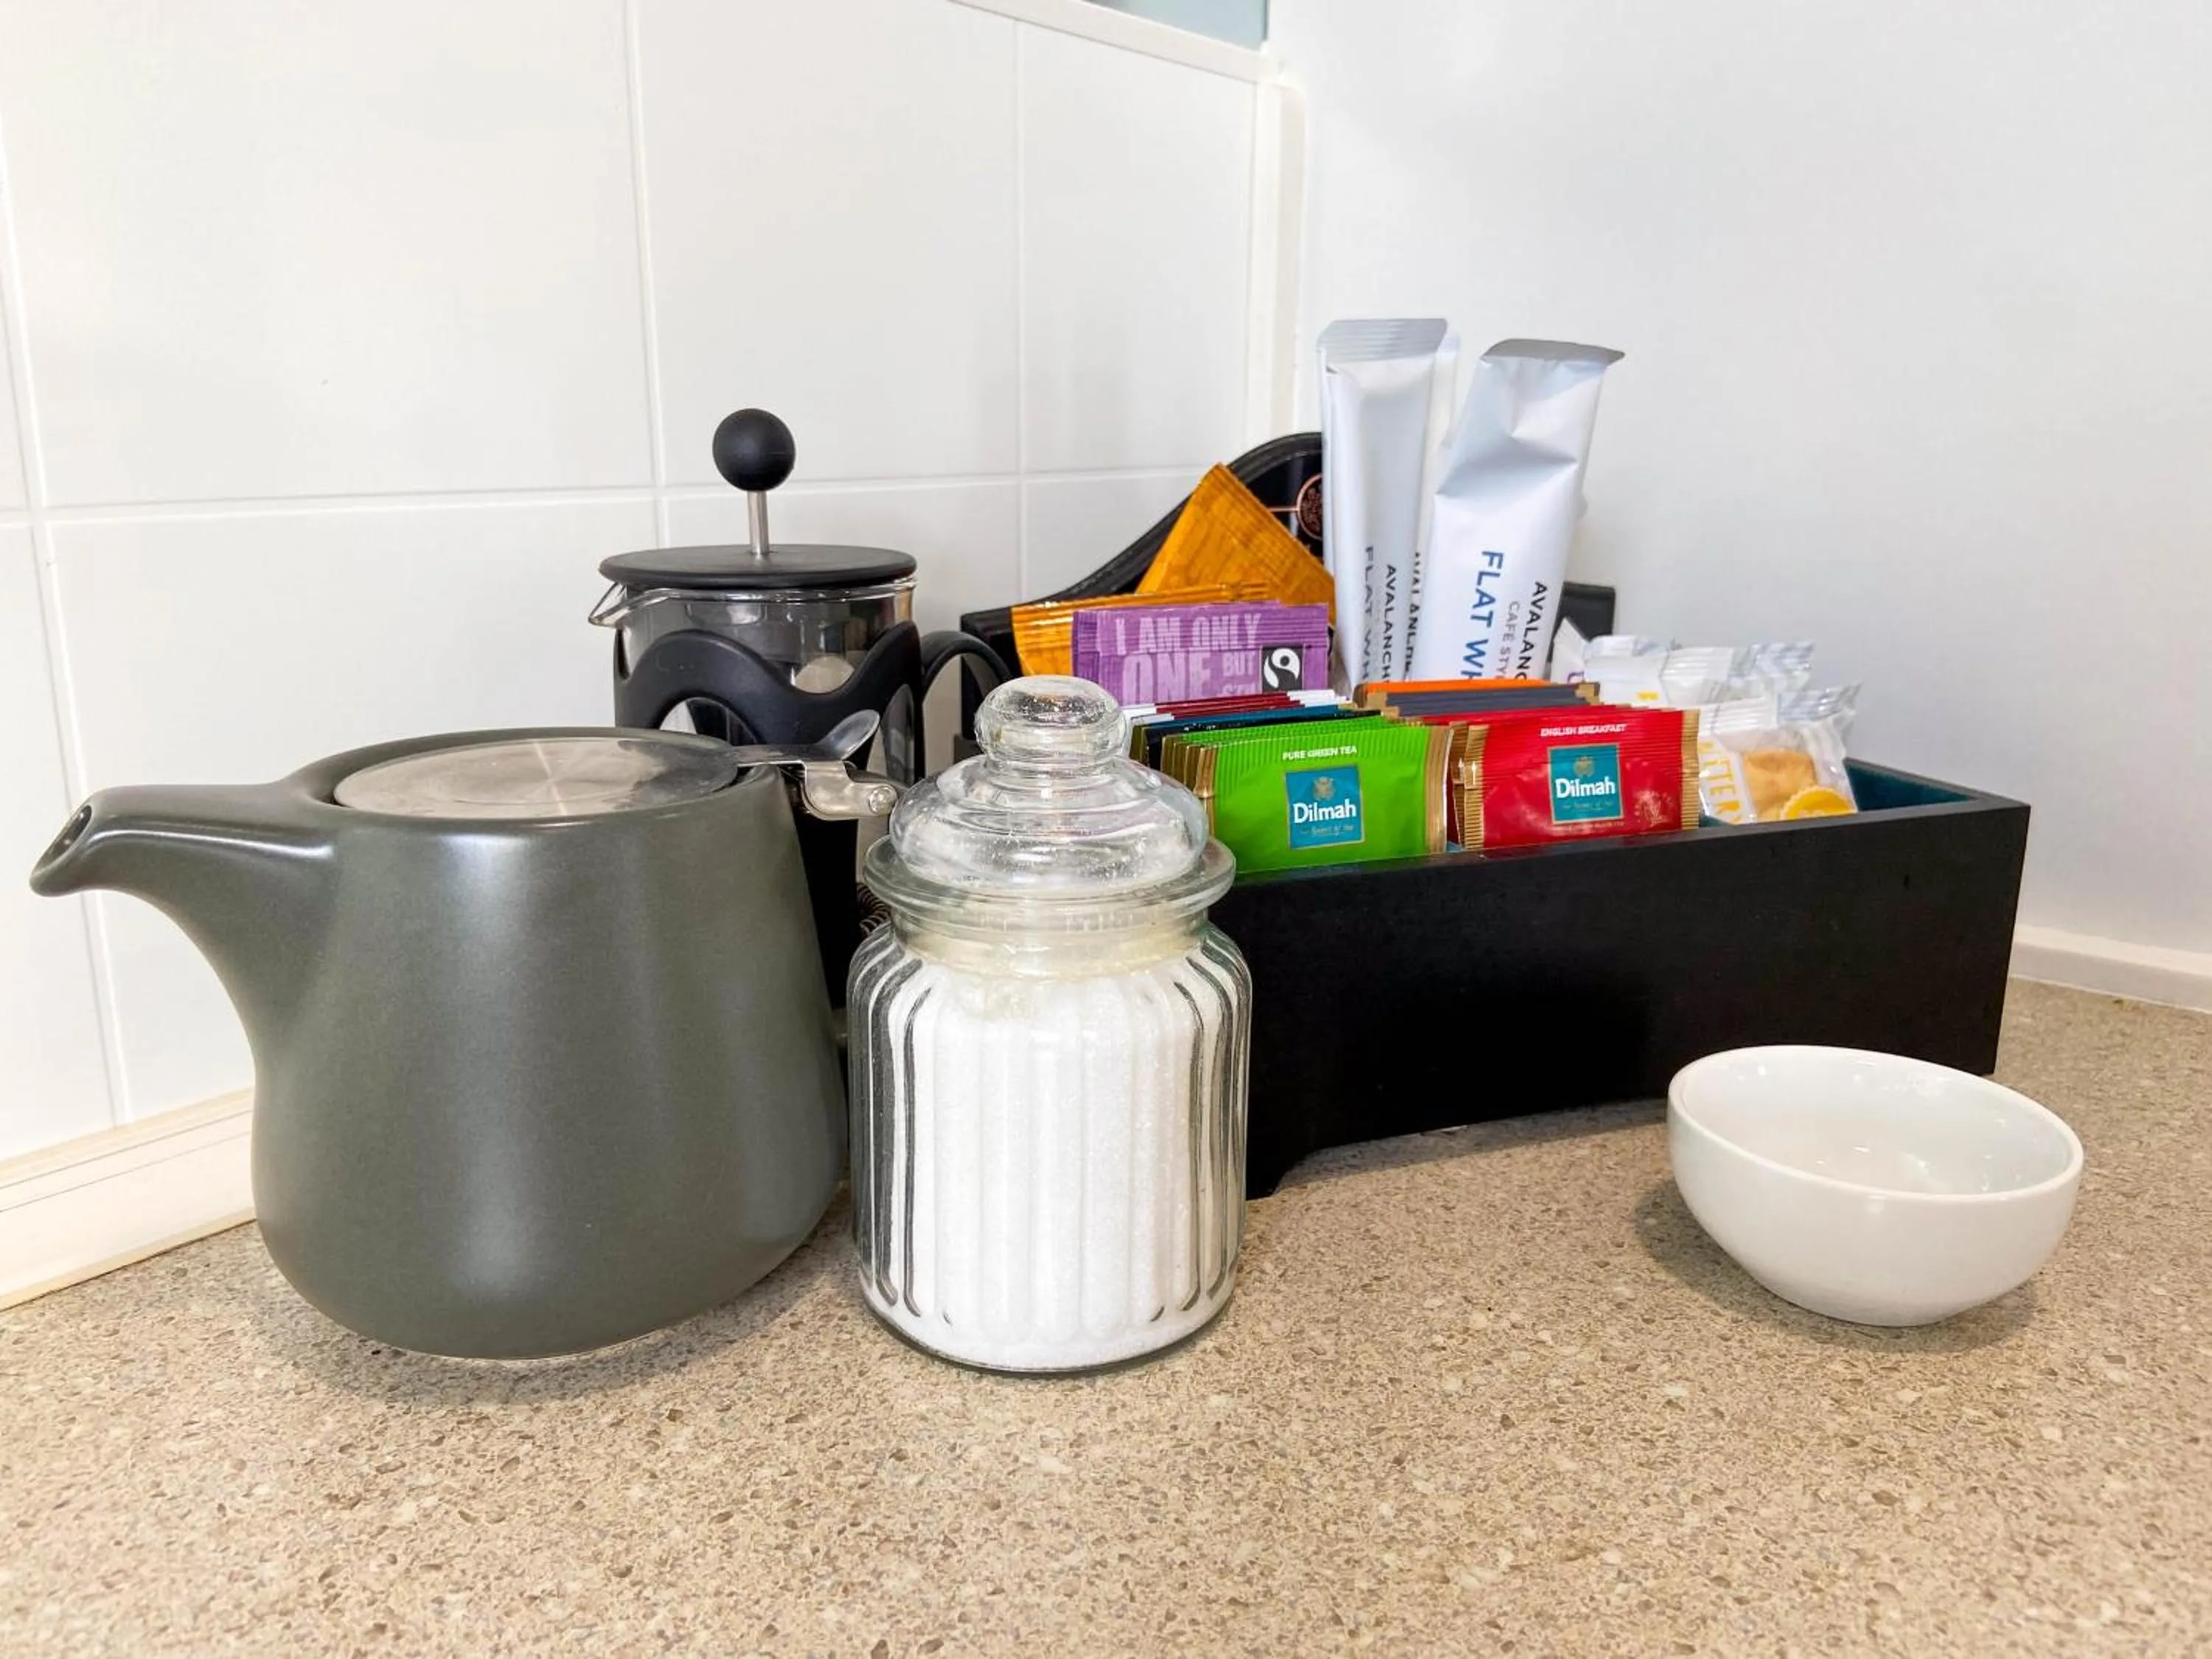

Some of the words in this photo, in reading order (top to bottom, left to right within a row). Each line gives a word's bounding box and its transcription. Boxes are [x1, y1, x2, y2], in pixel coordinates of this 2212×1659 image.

[1470, 551, 1505, 628] FLAT
[1115, 617, 1127, 655] I
[1138, 616, 1182, 653] AM
[1192, 613, 1262, 650] ONLY
[1381, 564, 1397, 683] AVALANCH
[1122, 649, 1213, 706] ONE
[1222, 651, 1256, 676] BUT
[1495, 646, 1512, 679] STY
[1282, 751, 1307, 761] PURE
[1340, 745, 1357, 755] TEA
[1555, 776, 1615, 799] Dilmah
[1293, 798, 1357, 824] Dilmah
